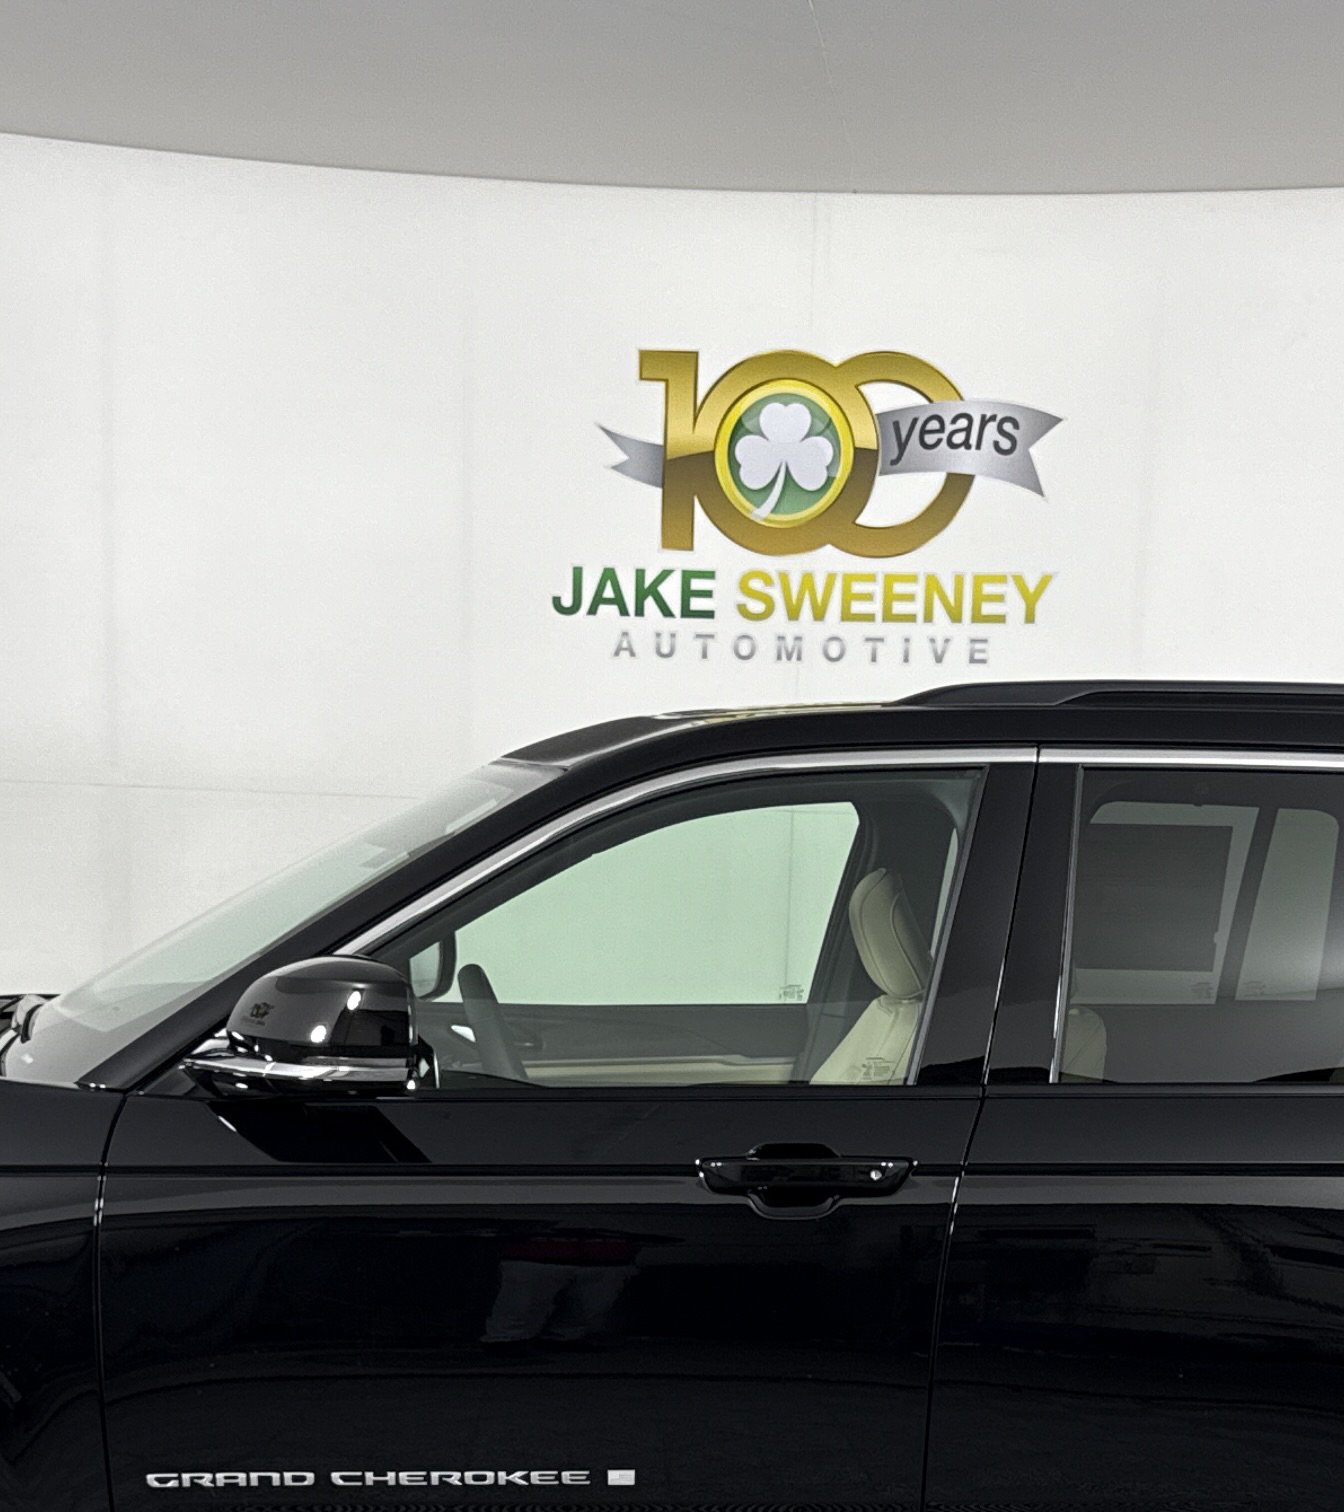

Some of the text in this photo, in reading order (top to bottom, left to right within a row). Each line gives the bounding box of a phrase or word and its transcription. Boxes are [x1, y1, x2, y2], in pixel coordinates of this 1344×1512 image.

[638, 349, 976, 558] 100
[889, 411, 1022, 467] years
[552, 566, 1055, 625] JAKE SWEENEY
[612, 631, 989, 665] AUTOMOTIVE
[145, 1470, 591, 1488] GRAND CHEROKEE
